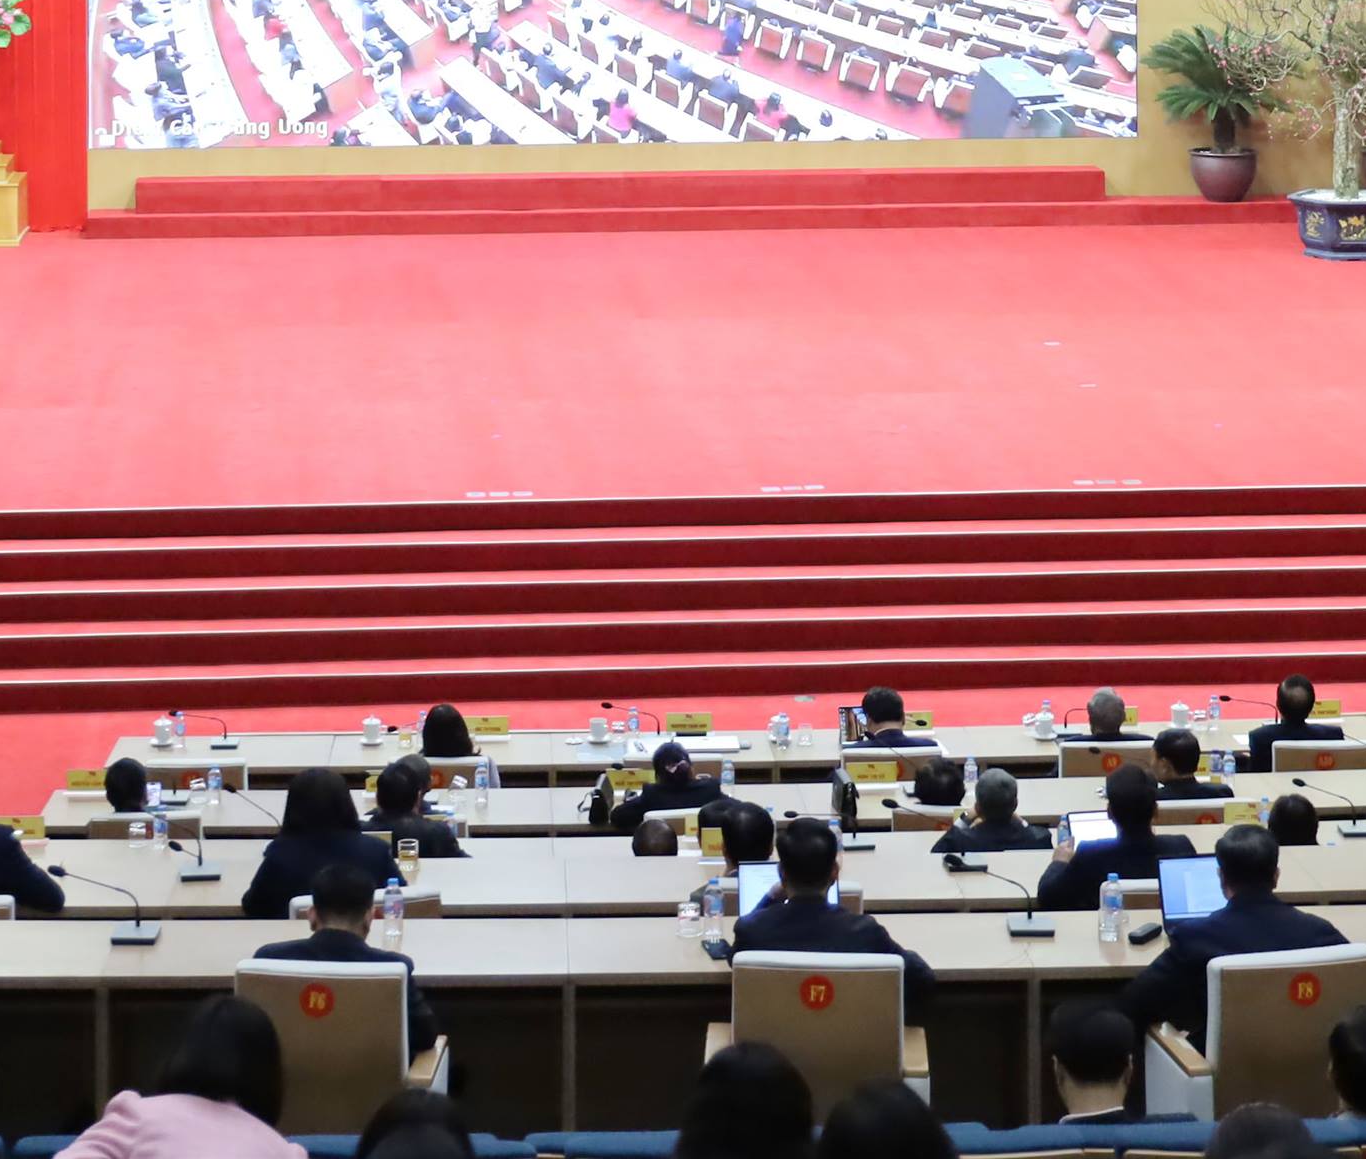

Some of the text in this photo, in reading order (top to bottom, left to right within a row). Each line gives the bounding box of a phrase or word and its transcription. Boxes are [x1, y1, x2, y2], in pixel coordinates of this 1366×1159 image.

[809, 984, 826, 1002] F7
[1297, 981, 1314, 999] F8
[309, 991, 327, 1010] F6
